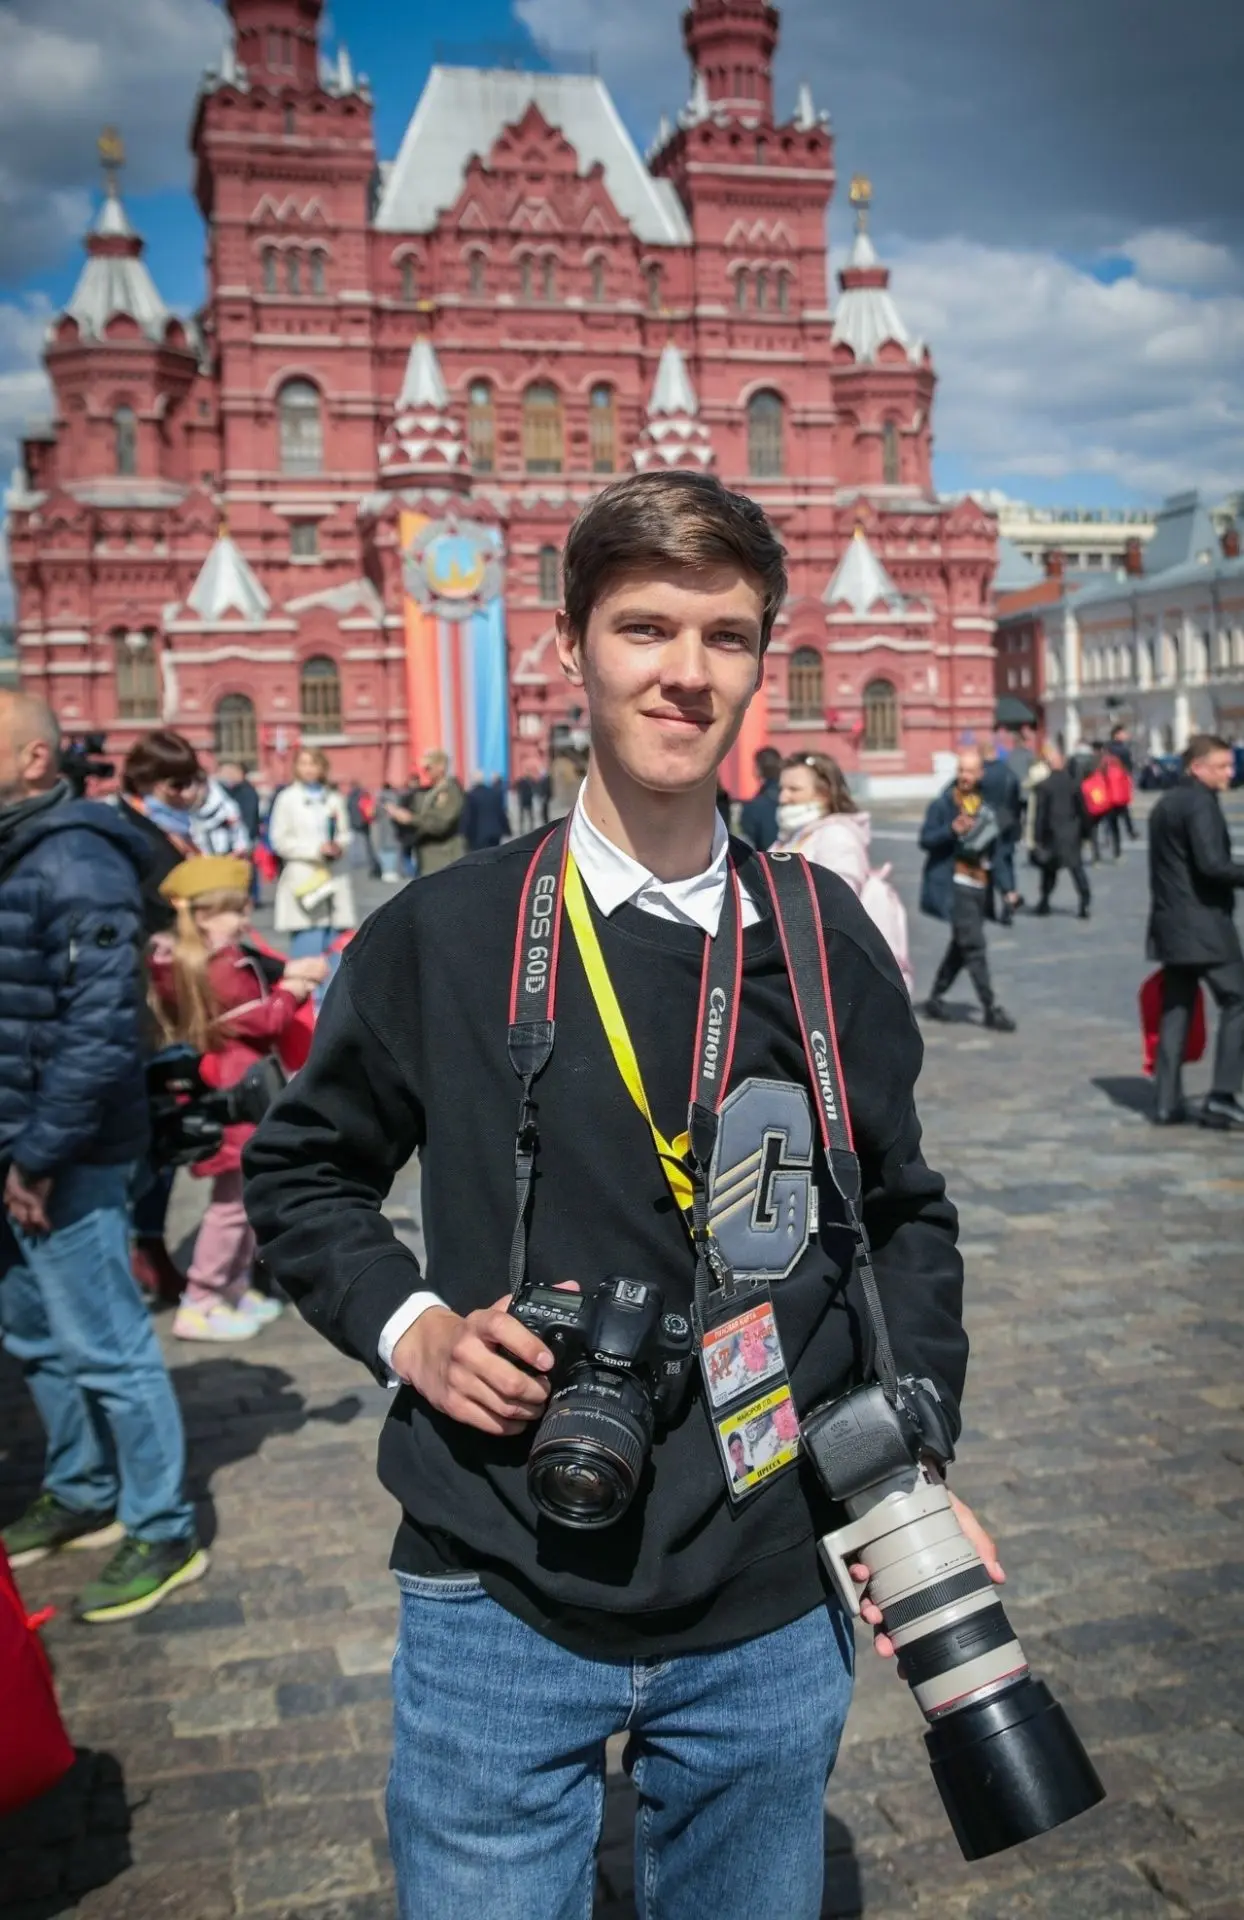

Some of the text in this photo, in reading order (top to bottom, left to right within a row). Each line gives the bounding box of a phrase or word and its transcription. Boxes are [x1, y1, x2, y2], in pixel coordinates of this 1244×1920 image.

[525, 875, 556, 994] EOS 60D
[703, 987, 727, 1080] Canon
[811, 1030, 838, 1121] Canon
[594, 1353, 632, 1368] Canon
[757, 1459, 781, 1478] ПРЕССА
